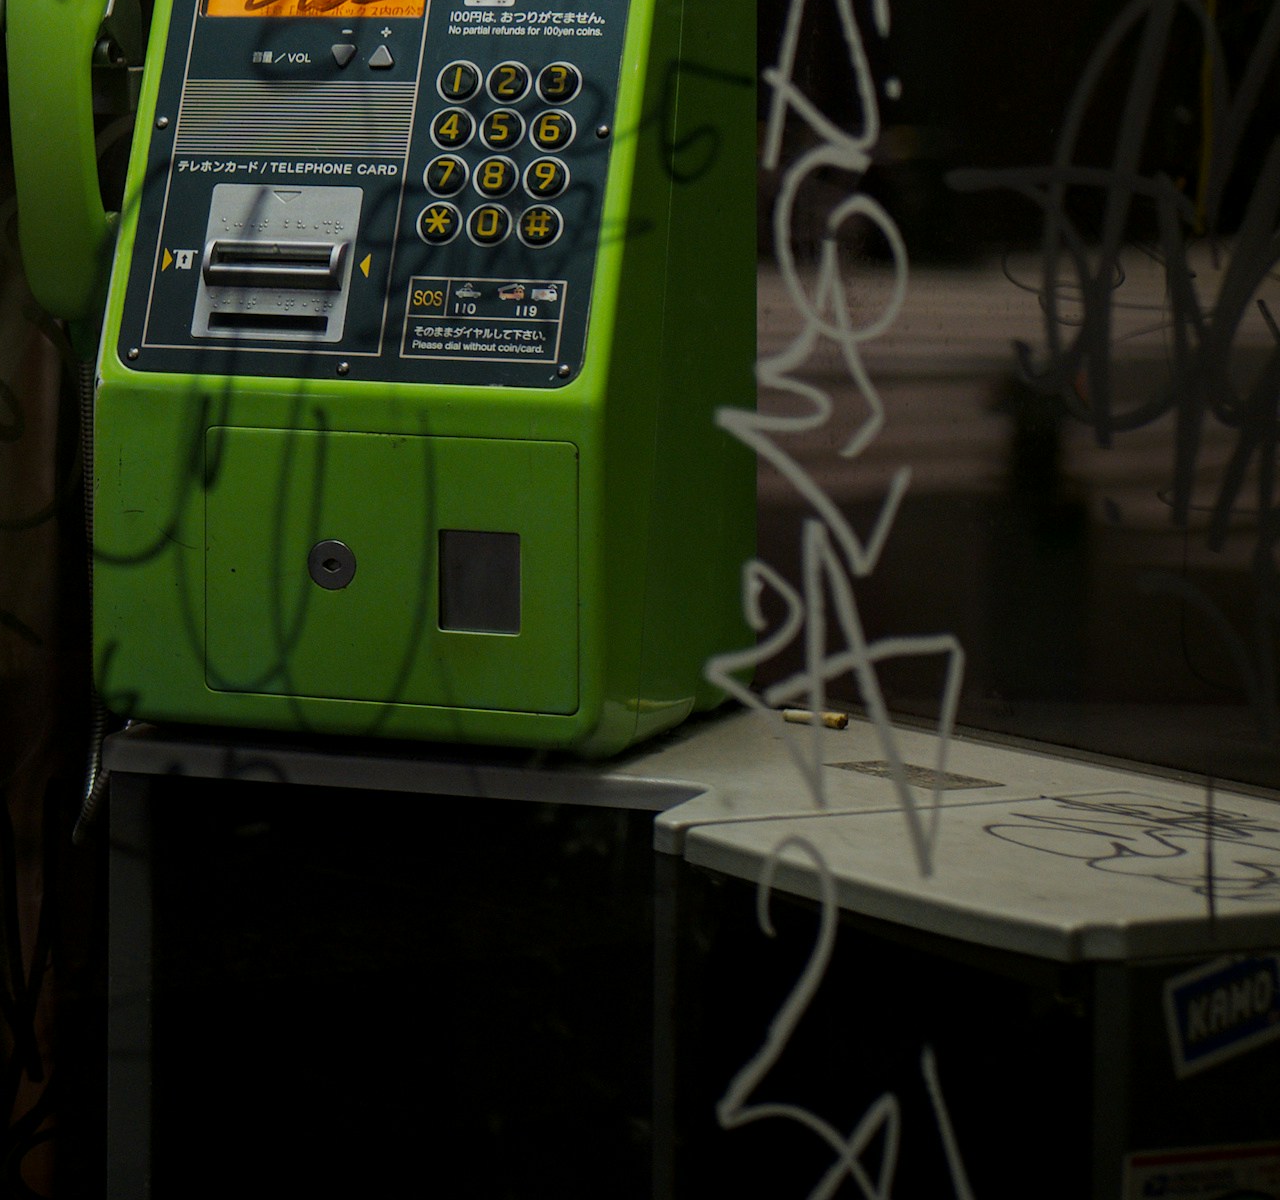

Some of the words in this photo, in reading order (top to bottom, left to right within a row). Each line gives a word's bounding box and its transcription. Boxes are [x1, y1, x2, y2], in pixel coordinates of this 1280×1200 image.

[448, 25, 461, 34] No
[462, 25, 490, 36] partial
[492, 26, 525, 36] refunds
[527, 26, 541, 36] for
[544, 26, 574, 37] 100yen
[576, 26, 603, 37] coins.
[451, 68, 462, 93] 1
[498, 68, 515, 95] 2
[548, 68, 566, 95] 3
[439, 115, 460, 141] 4
[492, 116, 509, 141] 5
[540, 116, 560, 143] 6
[177, 160, 259, 174] テレホンカード
[270, 162, 353, 175] TELEPHONE
[356, 164, 398, 176] CARD
[438, 162, 454, 187] 7
[483, 162, 504, 189] 8
[536, 164, 555, 190] 9
[478, 211, 497, 237] 0
[525, 212, 551, 237] #
[413, 290, 443, 307] SOS
[454, 302, 477, 315] 110
[515, 305, 538, 318] 119
[414, 326, 546, 342] そのままダイヤルして下さい。
[412, 339, 443, 350] Please
[444, 341, 462, 351] dial
[463, 342, 496, 352] without
[497, 343, 544, 354] coin/card.
